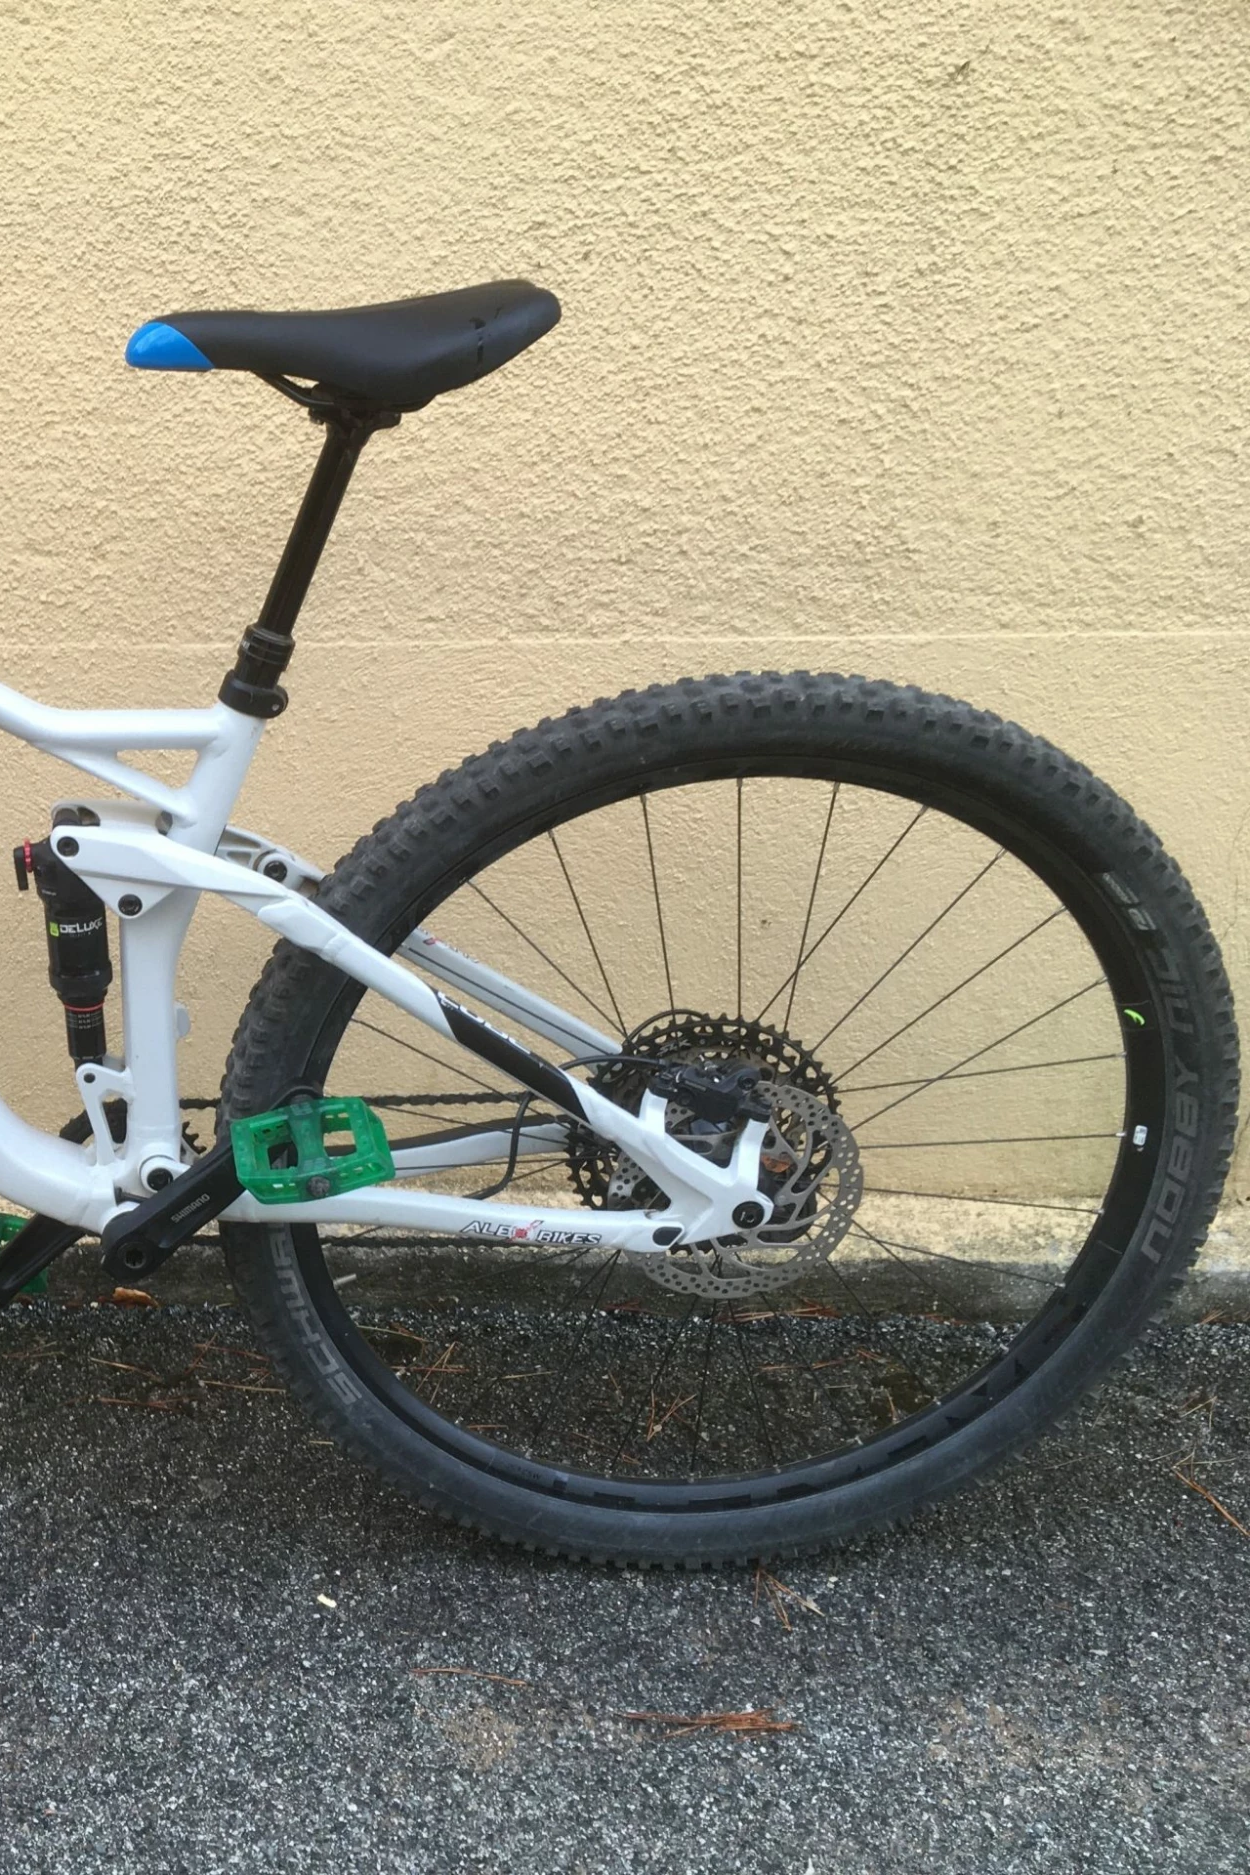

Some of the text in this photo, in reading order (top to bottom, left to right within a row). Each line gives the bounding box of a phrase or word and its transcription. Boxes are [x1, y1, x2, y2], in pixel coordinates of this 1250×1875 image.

[59, 917, 103, 934] DELUXE
[1141, 948, 1202, 1265] NOBBY NIC
[170, 1193, 211, 1224] SHIMANO
[536, 1229, 602, 1245] BIKES
